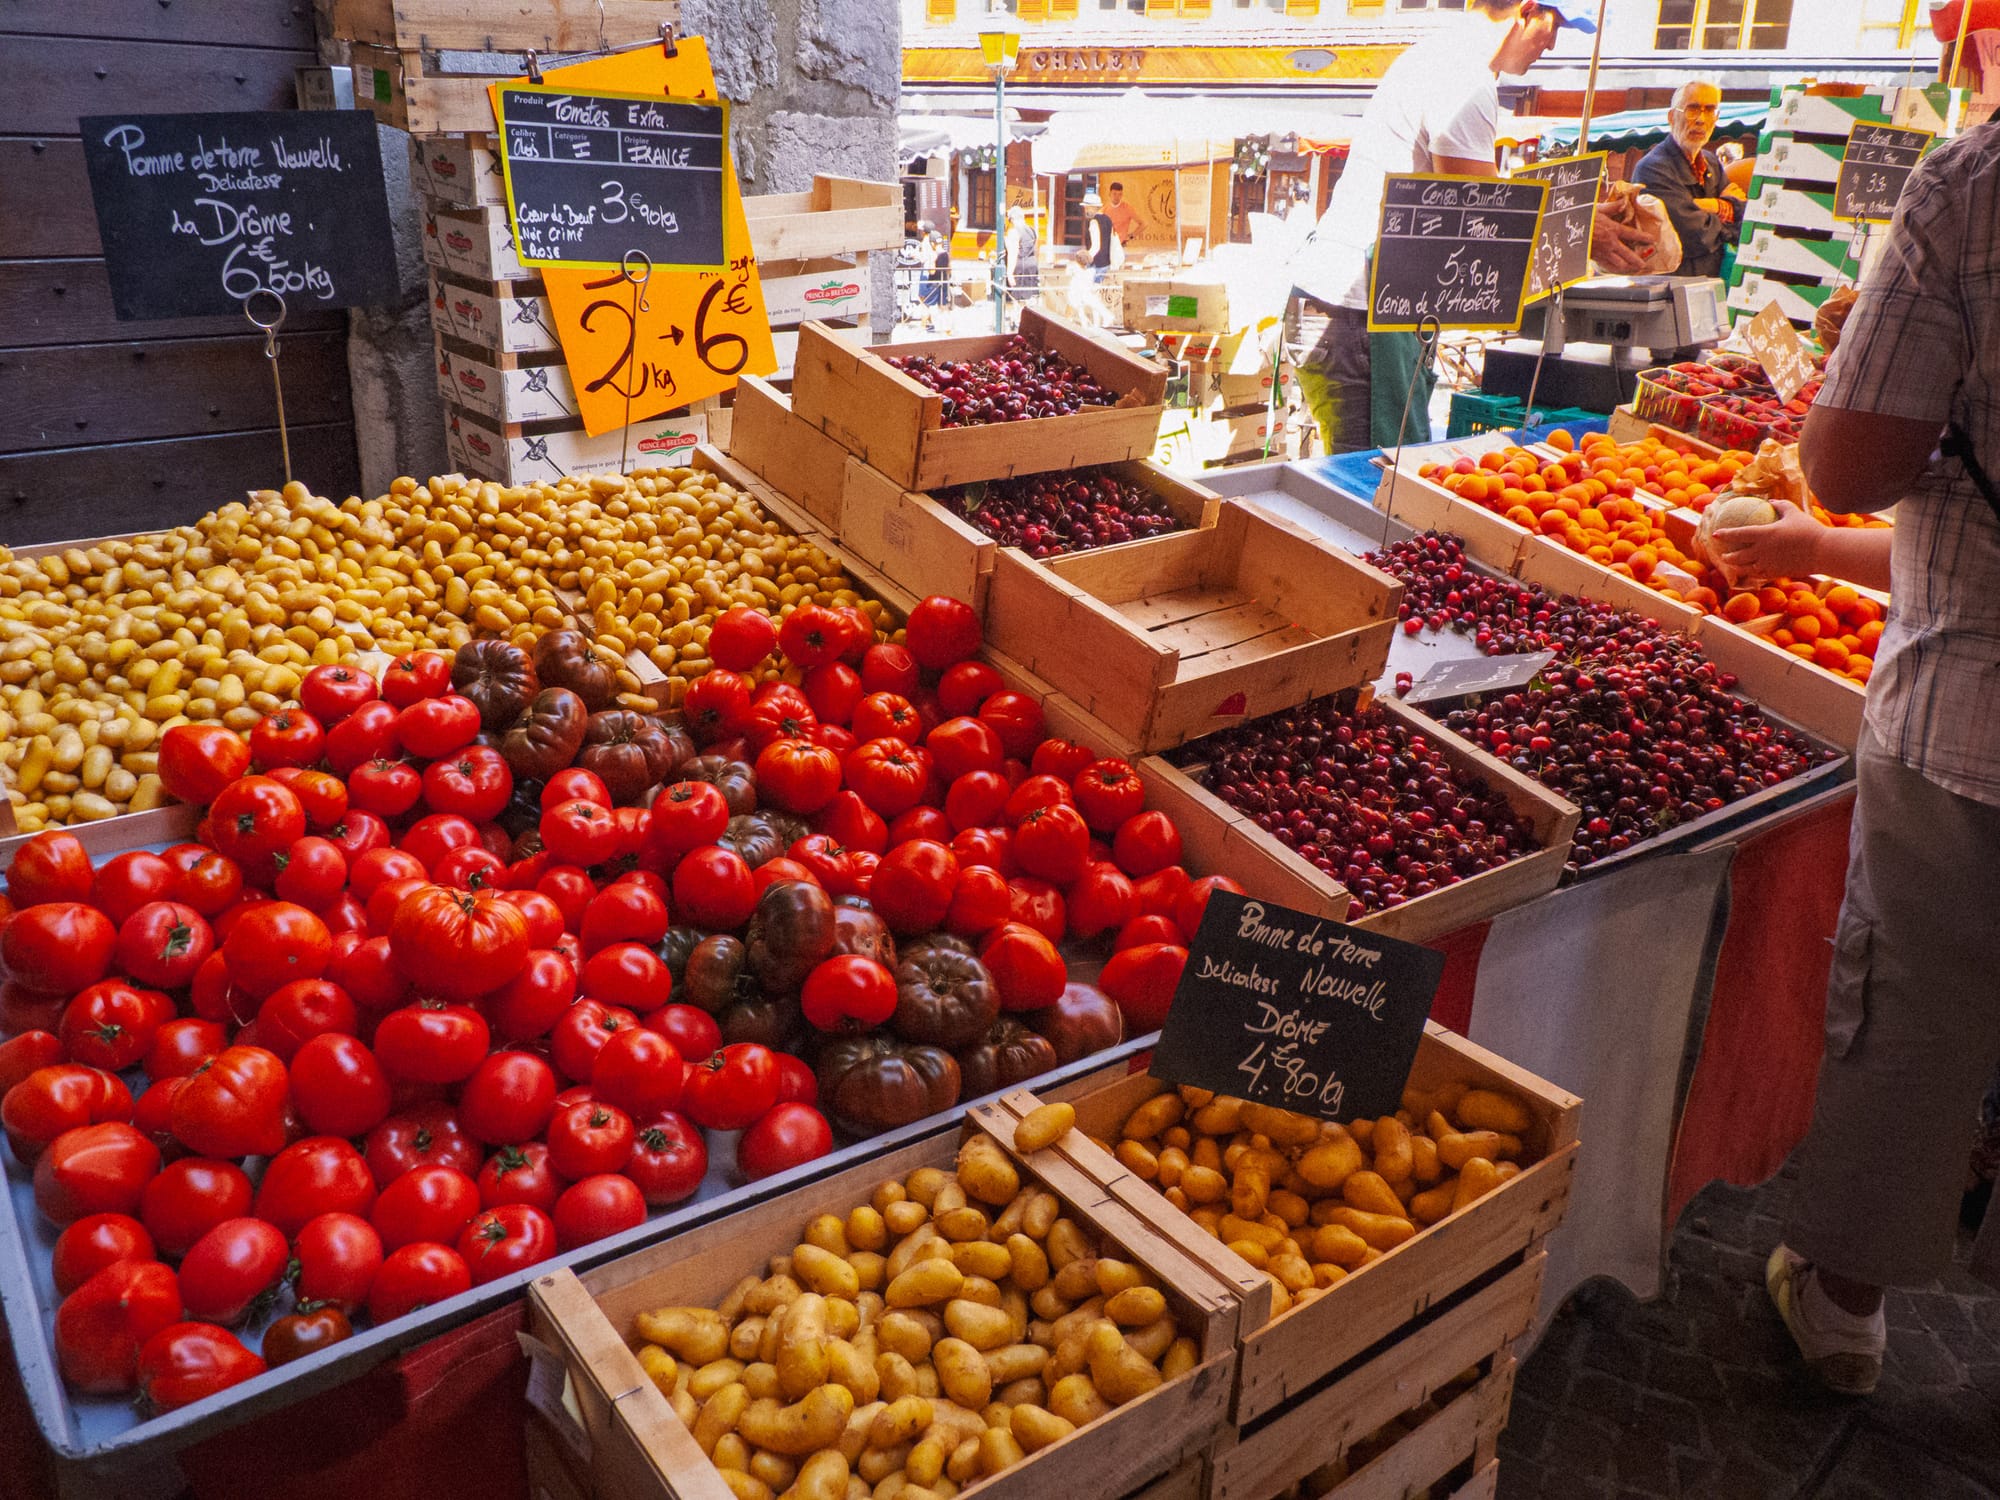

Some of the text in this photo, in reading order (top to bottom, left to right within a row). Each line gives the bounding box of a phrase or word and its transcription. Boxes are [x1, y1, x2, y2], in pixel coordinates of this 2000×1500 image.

[1031, 50, 1145, 71] CHALET
[514, 94, 544, 105] Produit
[546, 96, 610, 128] Tomates
[510, 128, 537, 139] Calibre
[624, 136, 650, 145] Origine
[627, 145, 692, 168] FRANCE
[1395, 181, 1417, 190] Produit
[1415, 291, 1429, 314] de
[639, 440, 661, 451] PRINCE
[666, 436, 697, 447] BRETAGNE
[1297, 921, 1321, 956] de
[1299, 963, 1387, 1021] Nouvelle
